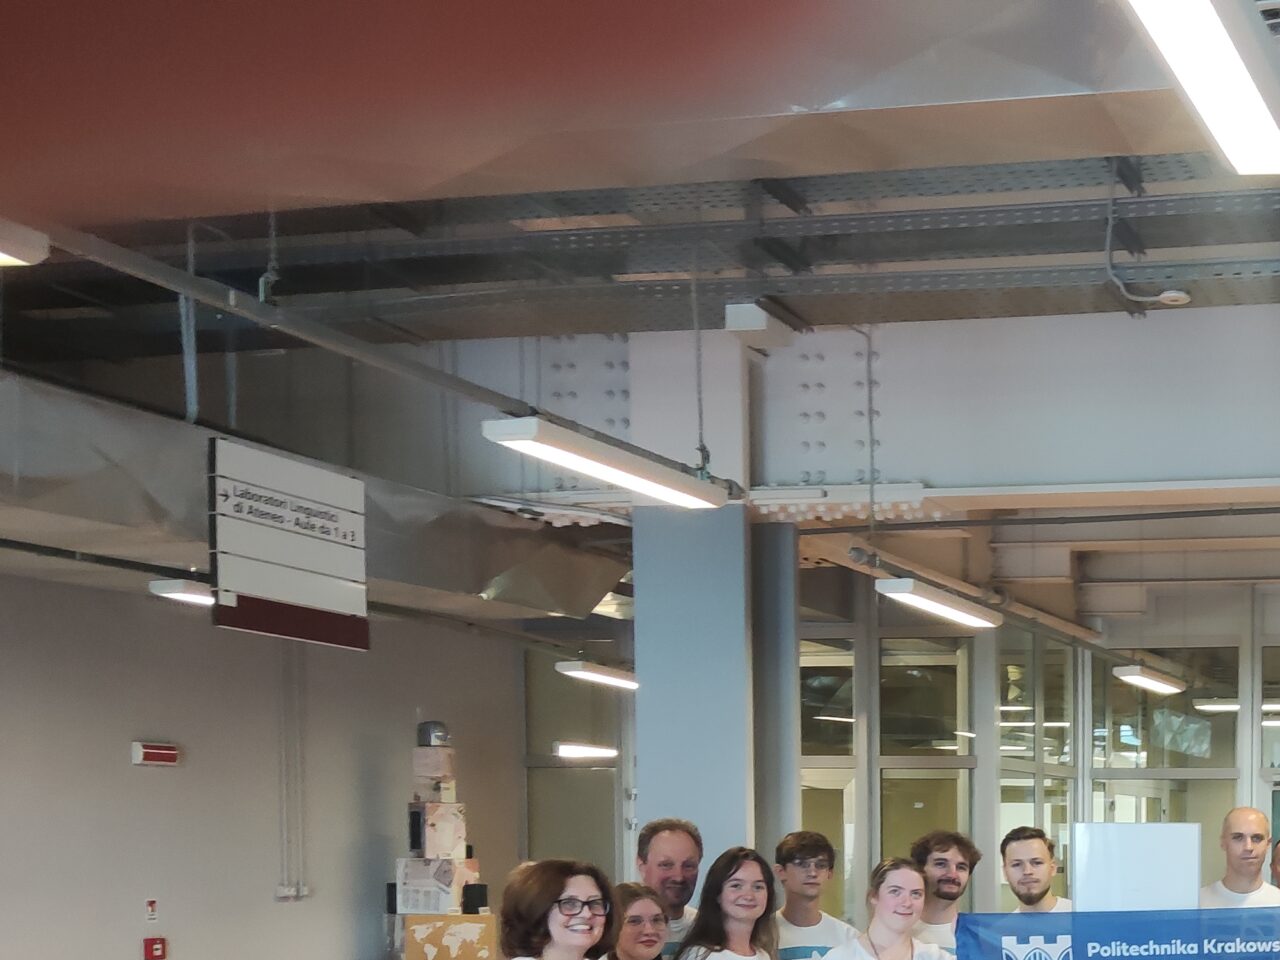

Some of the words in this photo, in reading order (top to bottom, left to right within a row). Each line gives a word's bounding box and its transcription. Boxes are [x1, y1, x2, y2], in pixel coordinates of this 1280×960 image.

[233, 485, 289, 509] Laboratori
[289, 500, 339, 523] Linguistici
[233, 501, 244, 514] di
[246, 505, 285, 524] Ateneo
[293, 516, 317, 532] Aule
[317, 525, 332, 537] da
[1087, 938, 1199, 958] Politechnika
